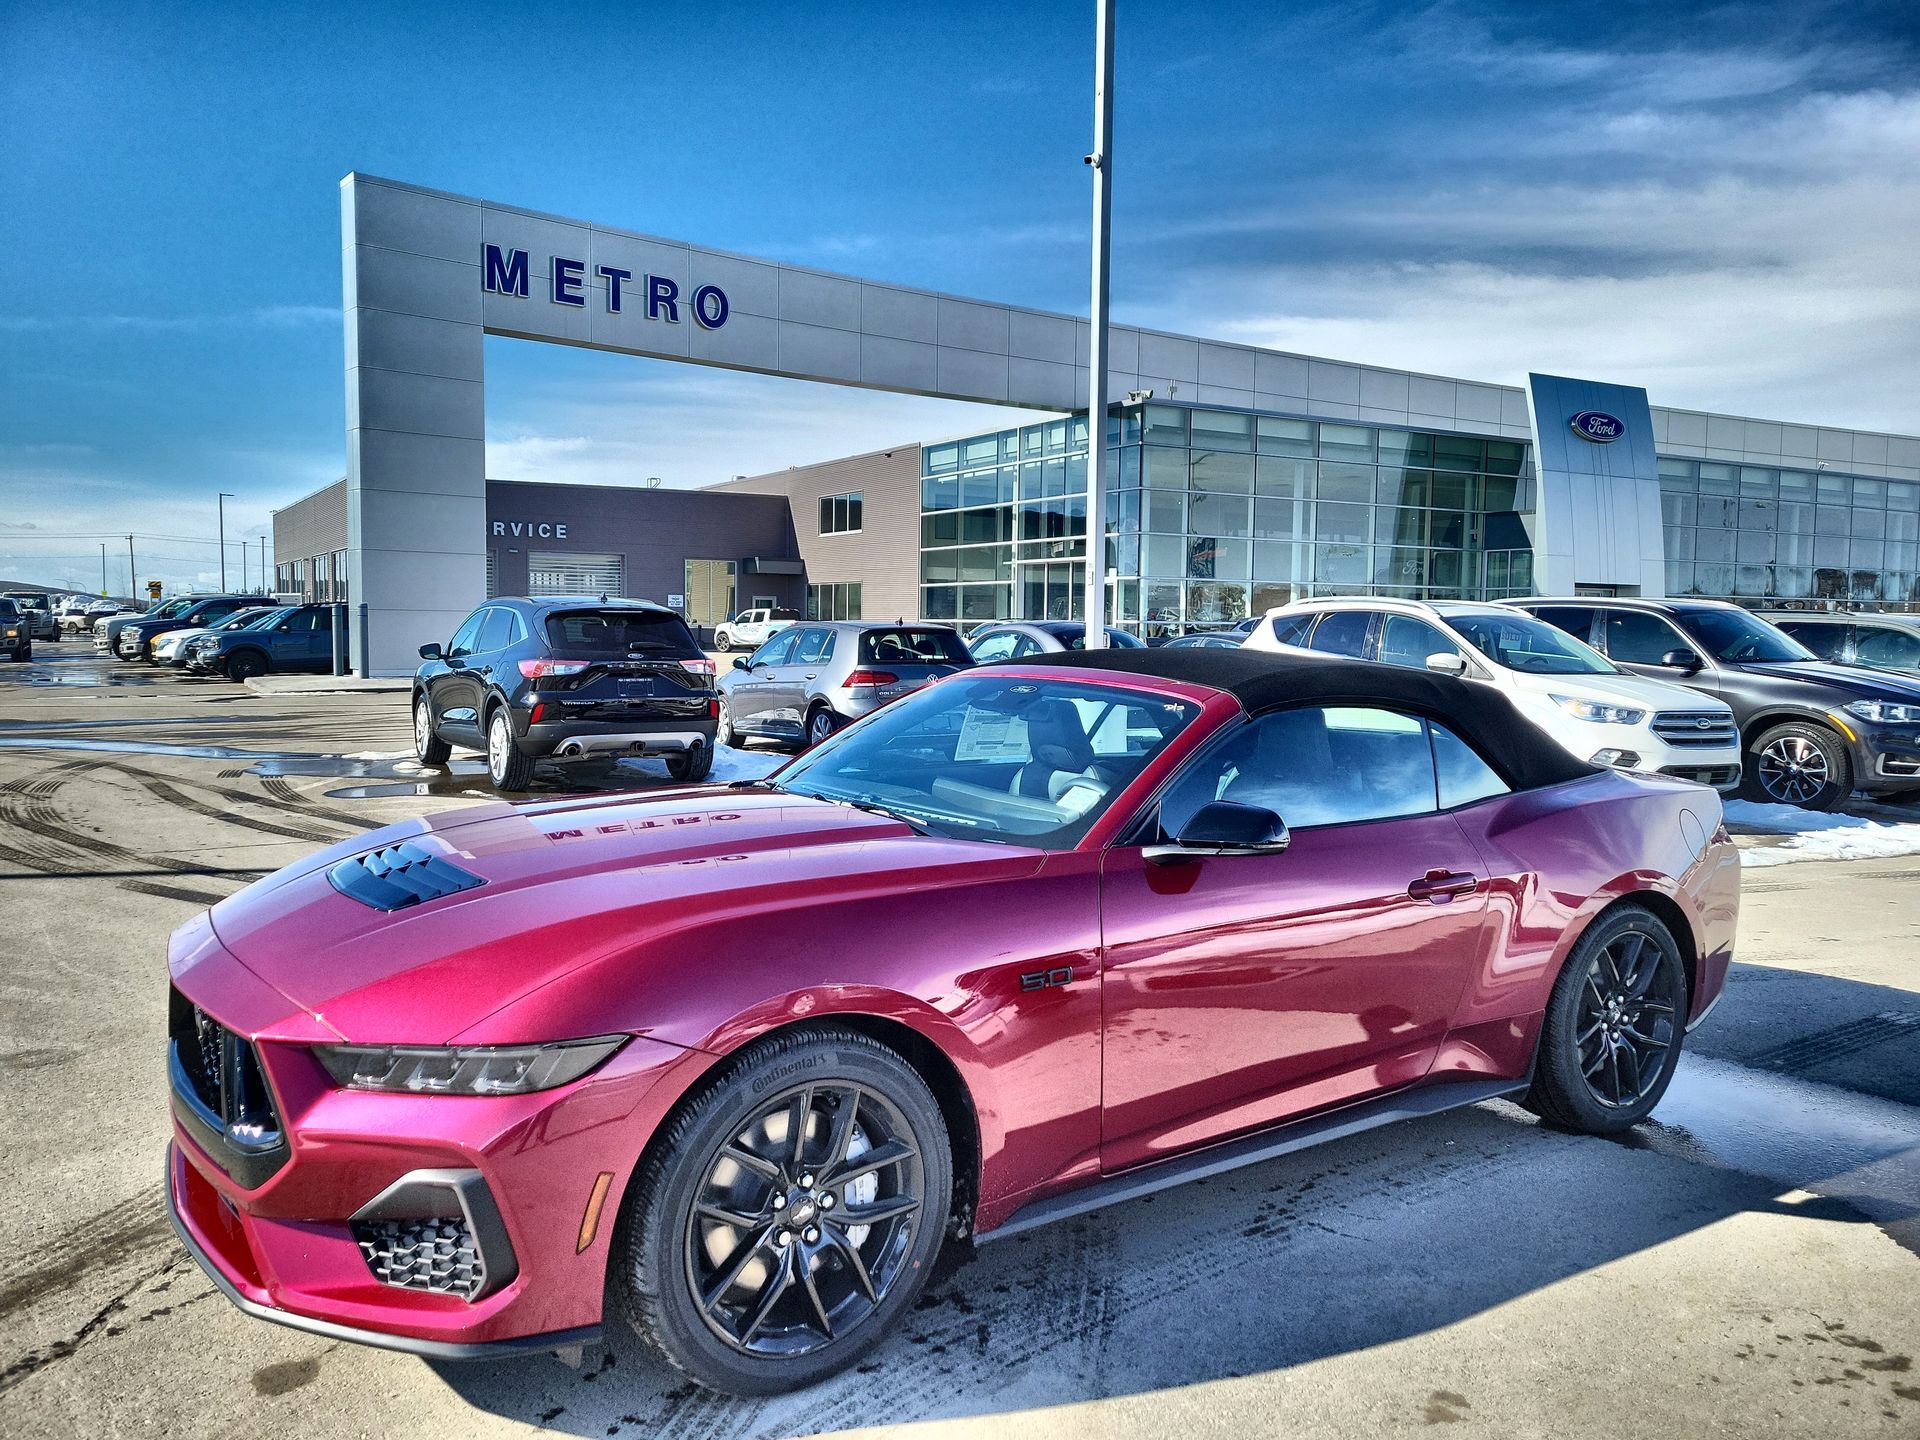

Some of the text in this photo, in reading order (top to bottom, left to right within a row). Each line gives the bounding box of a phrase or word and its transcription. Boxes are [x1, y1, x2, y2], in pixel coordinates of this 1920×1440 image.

[483, 243, 730, 330] METRO
[1588, 416, 1616, 435] Ford
[487, 521, 567, 539] RVICE
[752, 1055, 817, 1093] Continental
